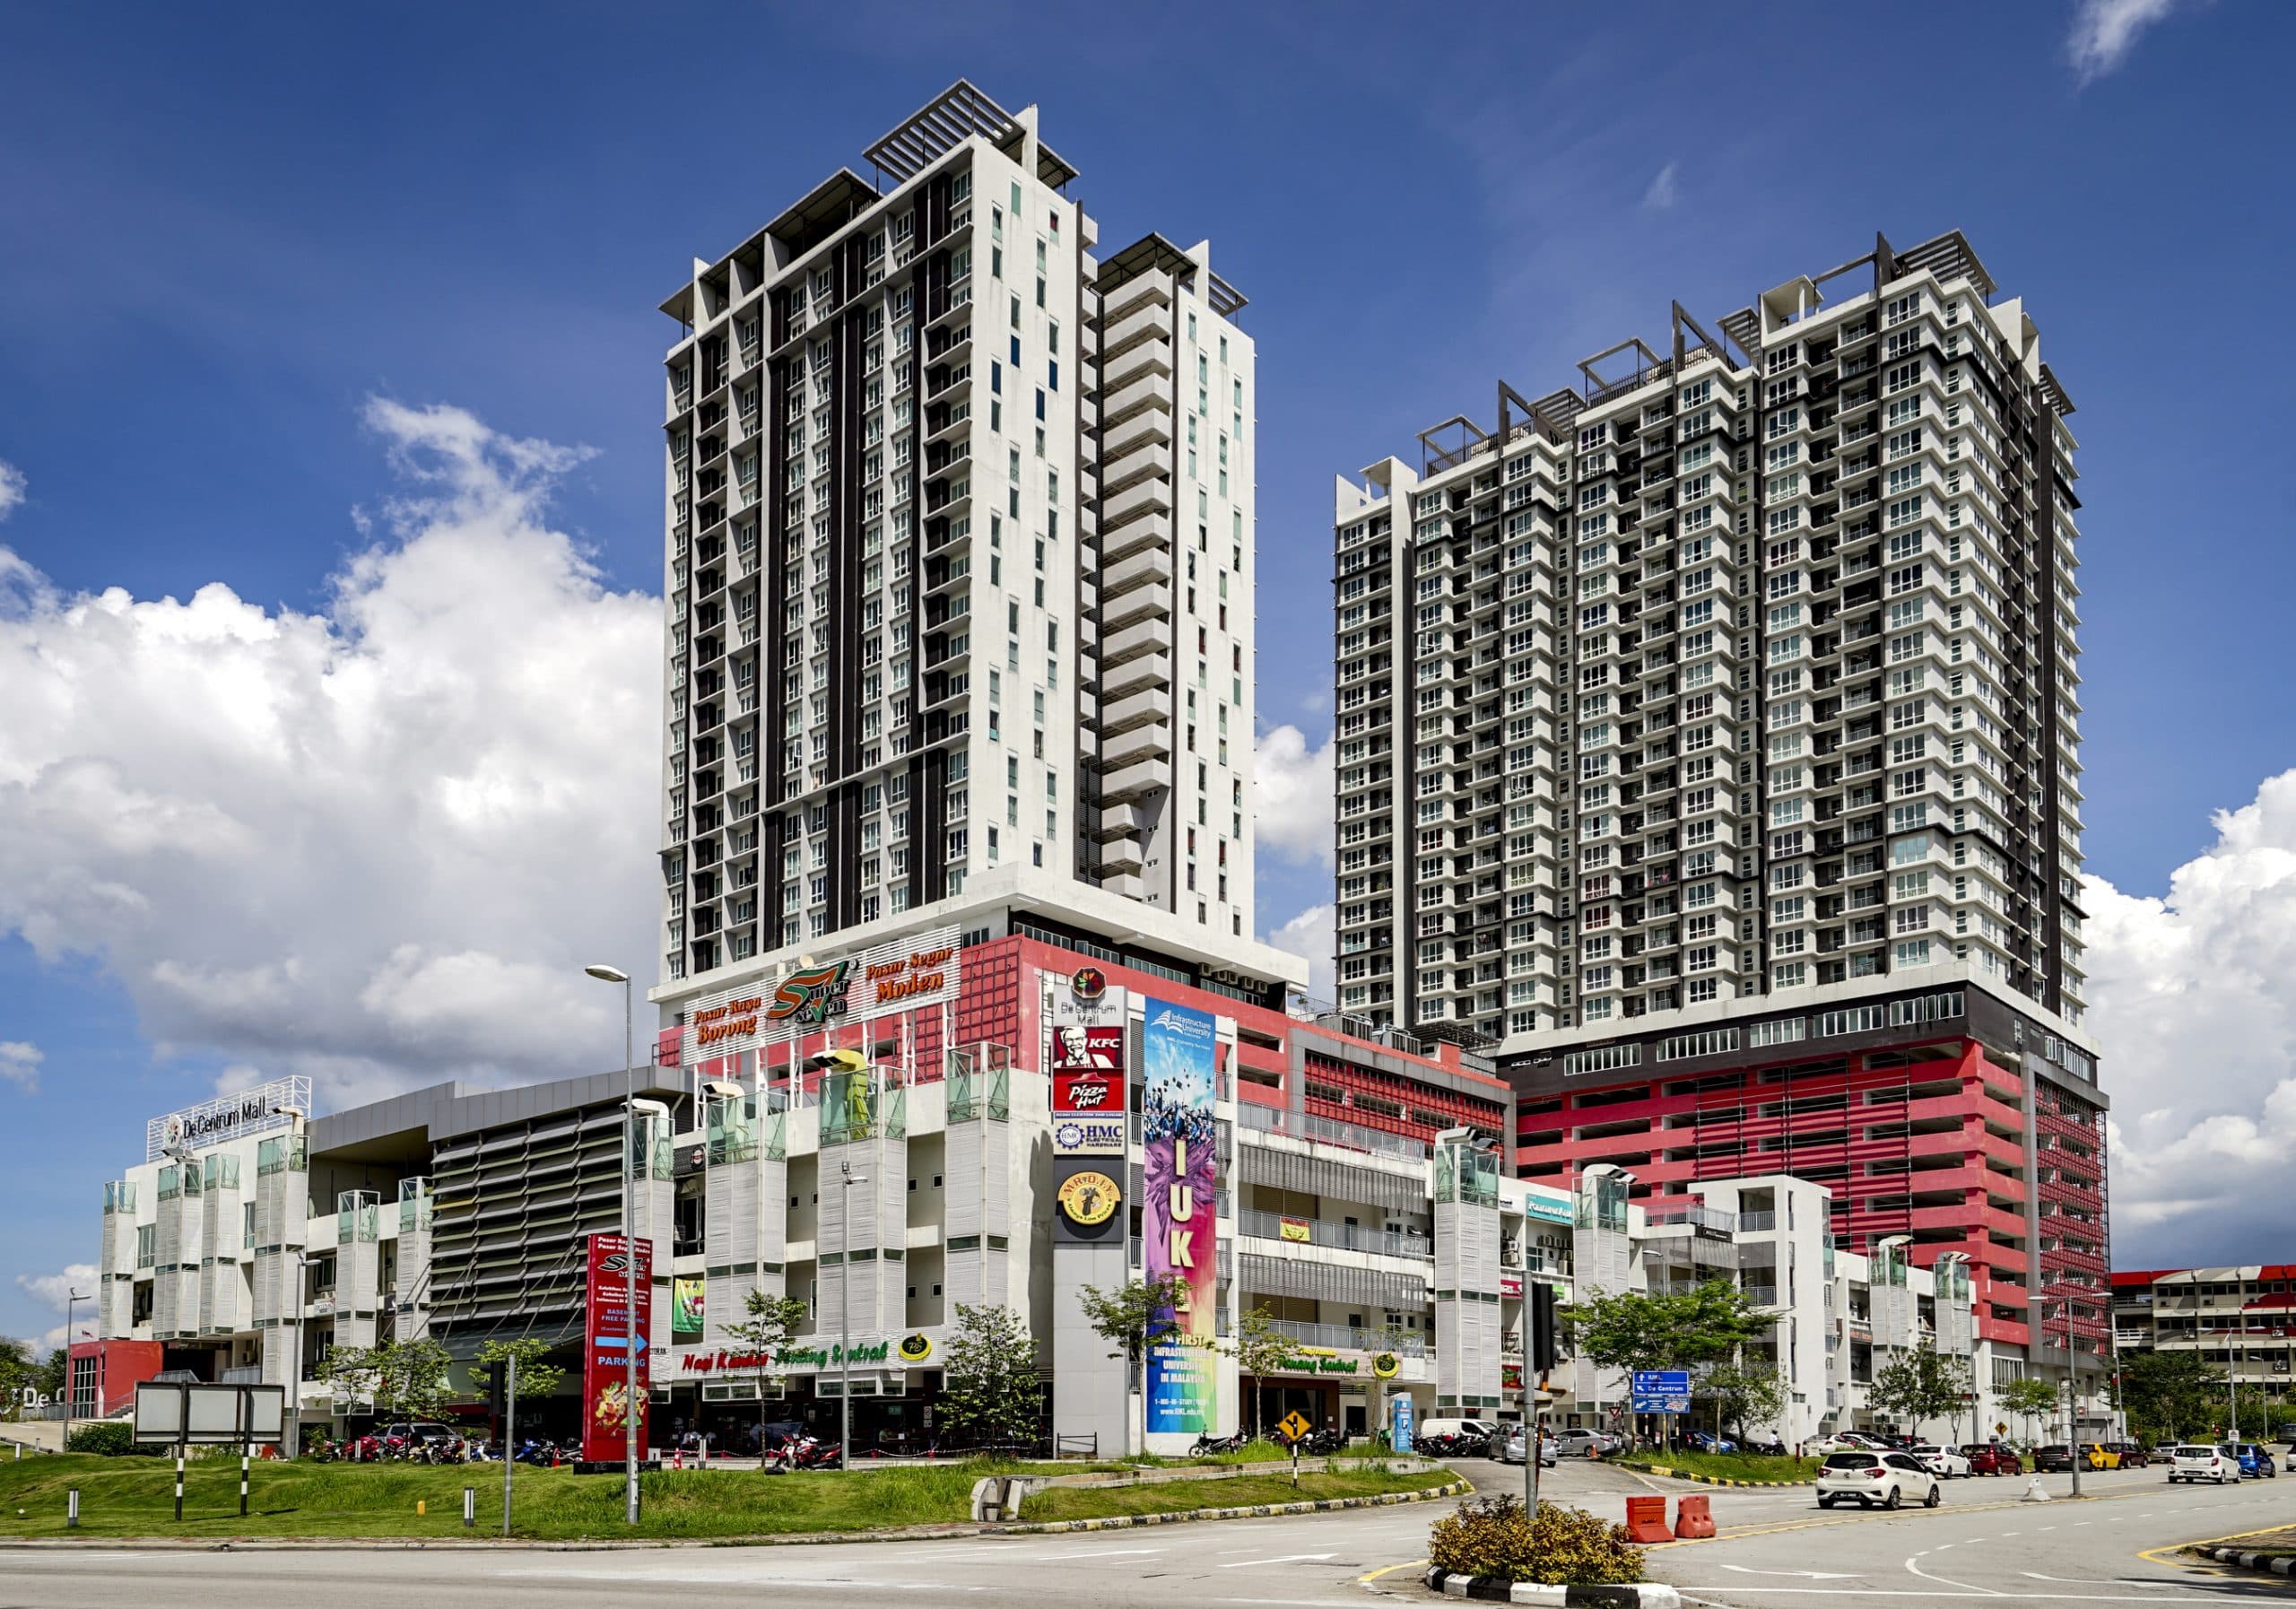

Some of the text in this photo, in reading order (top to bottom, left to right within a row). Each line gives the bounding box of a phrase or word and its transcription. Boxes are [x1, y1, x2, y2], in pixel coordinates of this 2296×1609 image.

[865, 947, 953, 980] Pasar Segar
[875, 972, 944, 1003] Moden
[694, 997, 761, 1024] Pasar Raya
[1077, 1014, 1100, 1025] Mall
[698, 1015, 757, 1044] Borong
[1088, 1038, 1121, 1048] KFC
[1068, 1083, 1109, 1101] Pizza
[1075, 1093, 1106, 1110] Hut
[184, 1095, 269, 1139] De Centrum Mall
[1086, 1126, 1123, 1137] HMC
[598, 1356, 646, 1367] PARKNG
[832, 1341, 888, 1362] Sntral
[23, 1387, 50, 1408] De
